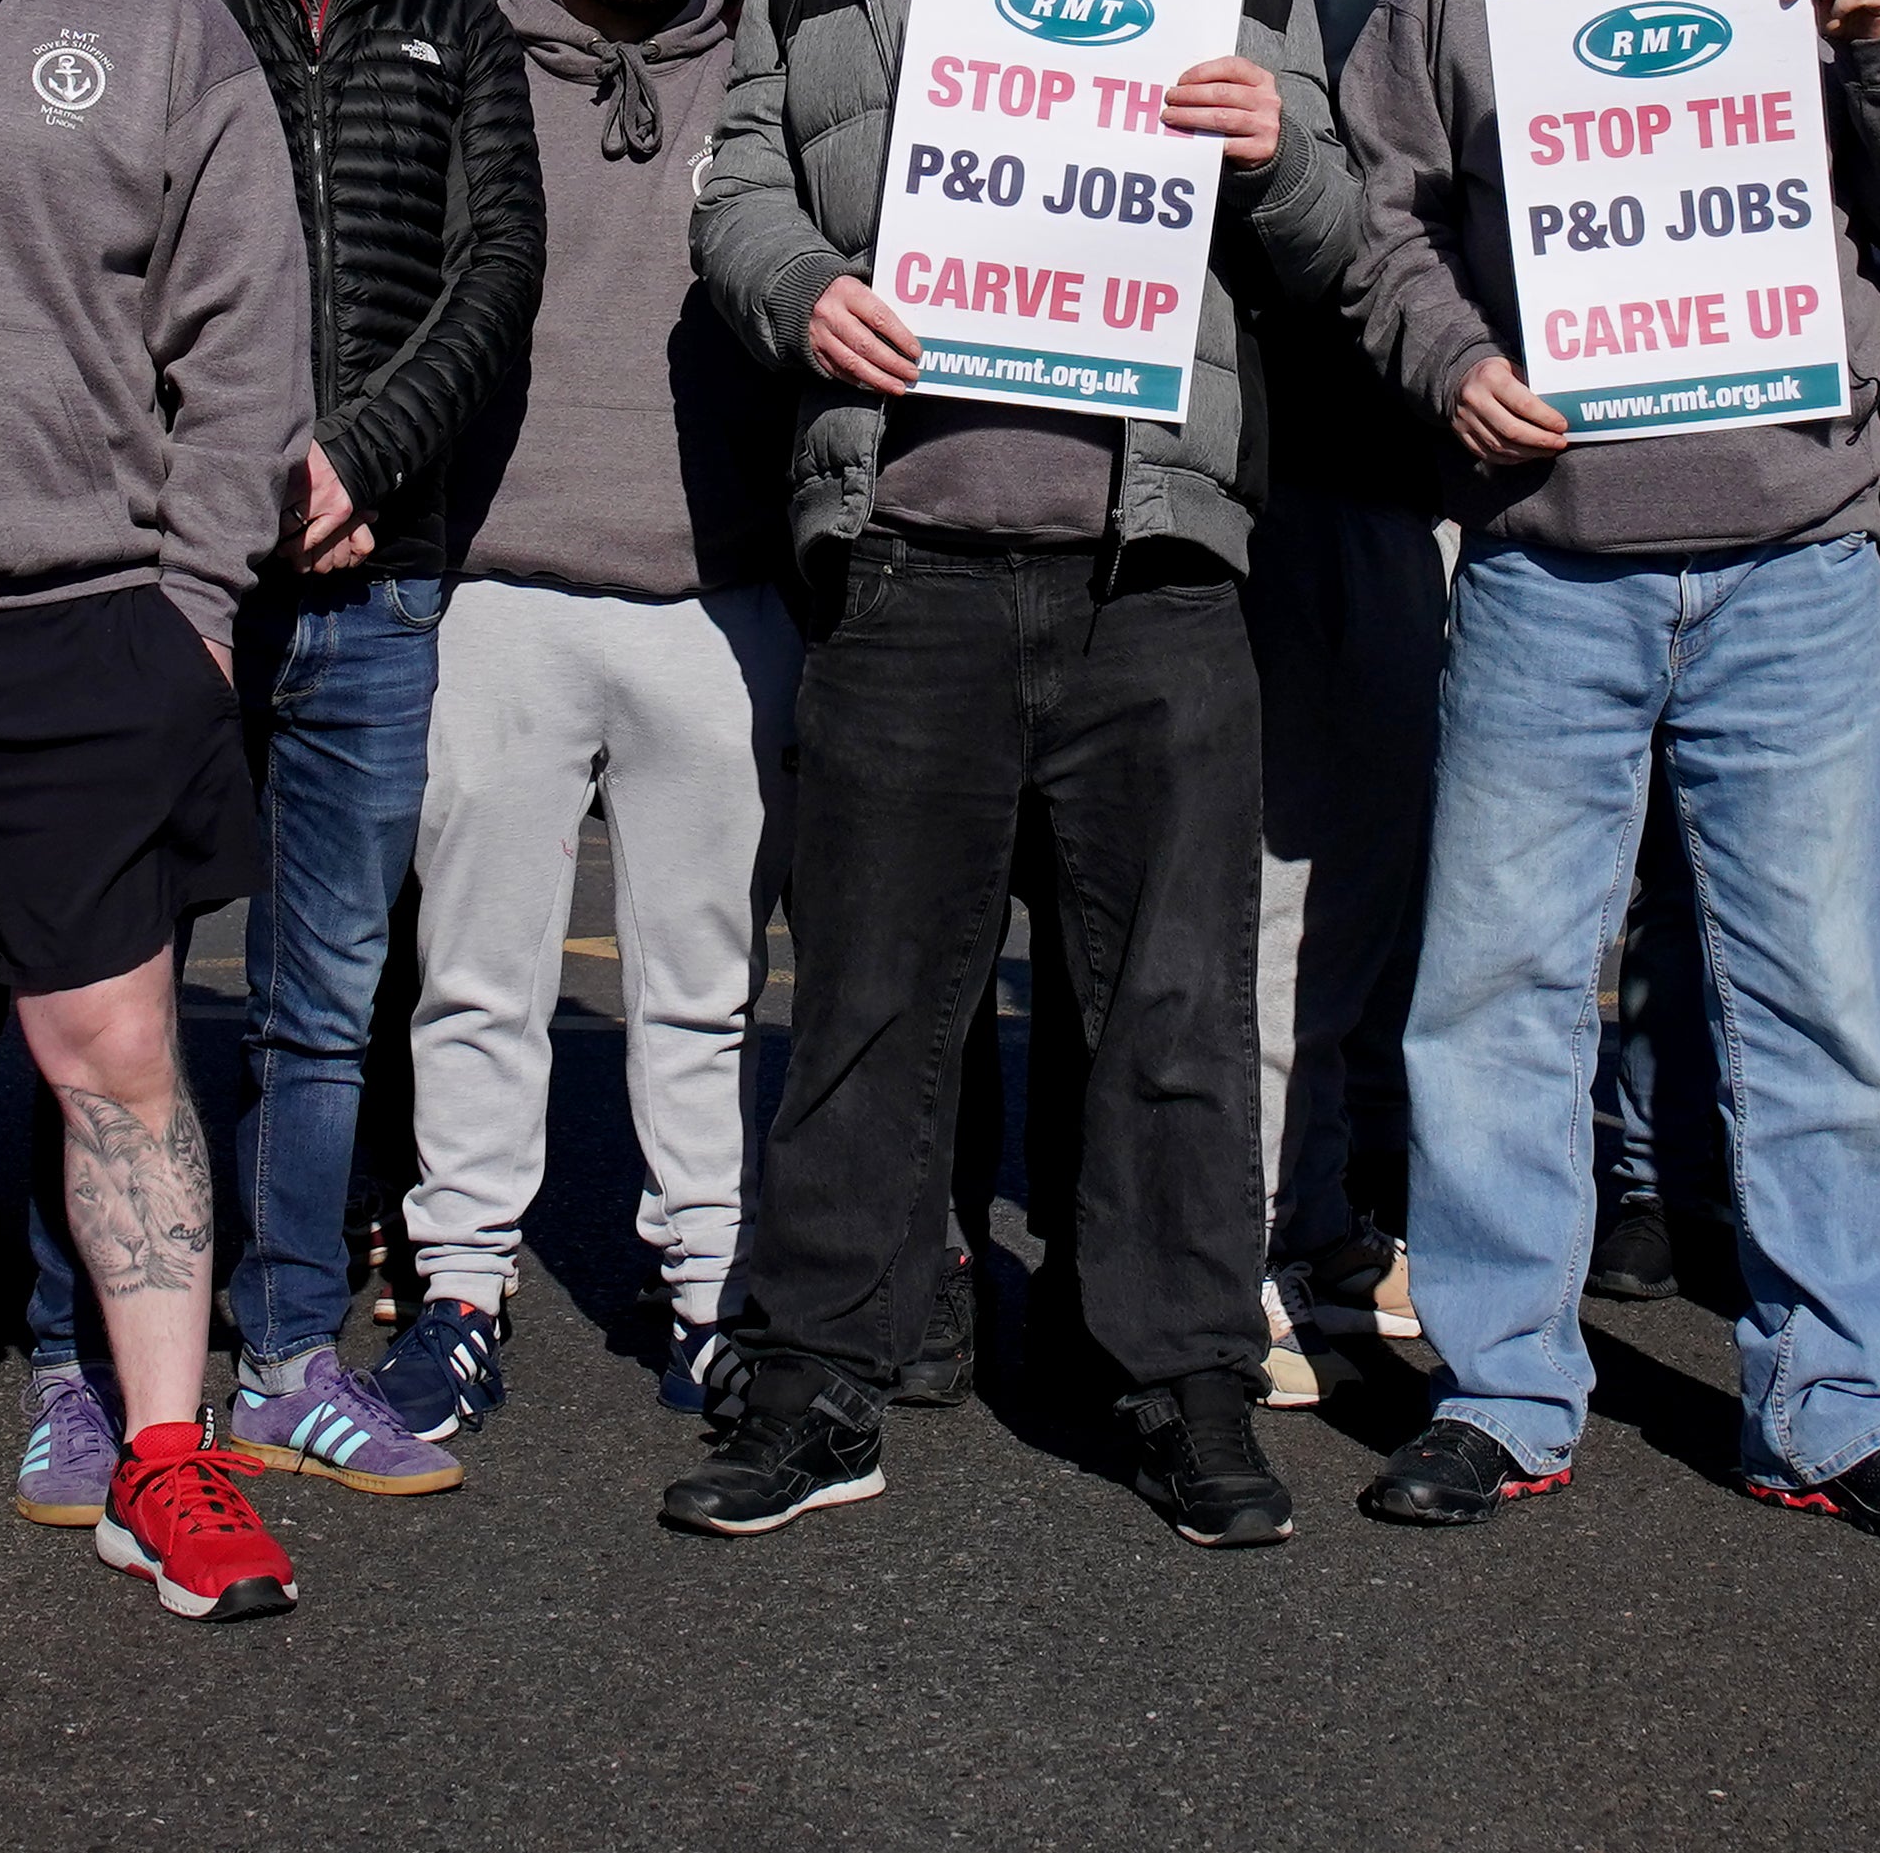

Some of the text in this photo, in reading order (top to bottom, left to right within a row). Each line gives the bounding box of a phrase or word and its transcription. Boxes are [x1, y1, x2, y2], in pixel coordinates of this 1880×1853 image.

[32, 40, 116, 72] DOVER SHIPPING
[60, 28, 100, 43] RMT
[1610, 23, 1701, 58] RMT
[927, 55, 1076, 121] STOP
[1528, 91, 1796, 167] STOP THE
[904, 143, 1195, 230] P&O JOBS
[1528, 178, 1813, 257] P&O JOBS
[894, 251, 1179, 333] CARVE UP
[1544, 284, 1820, 362] CARVE UP
[917, 347, 1140, 397] www.rmt.org.uk
[1579, 375, 1802, 422] www.rmt.org.uk
